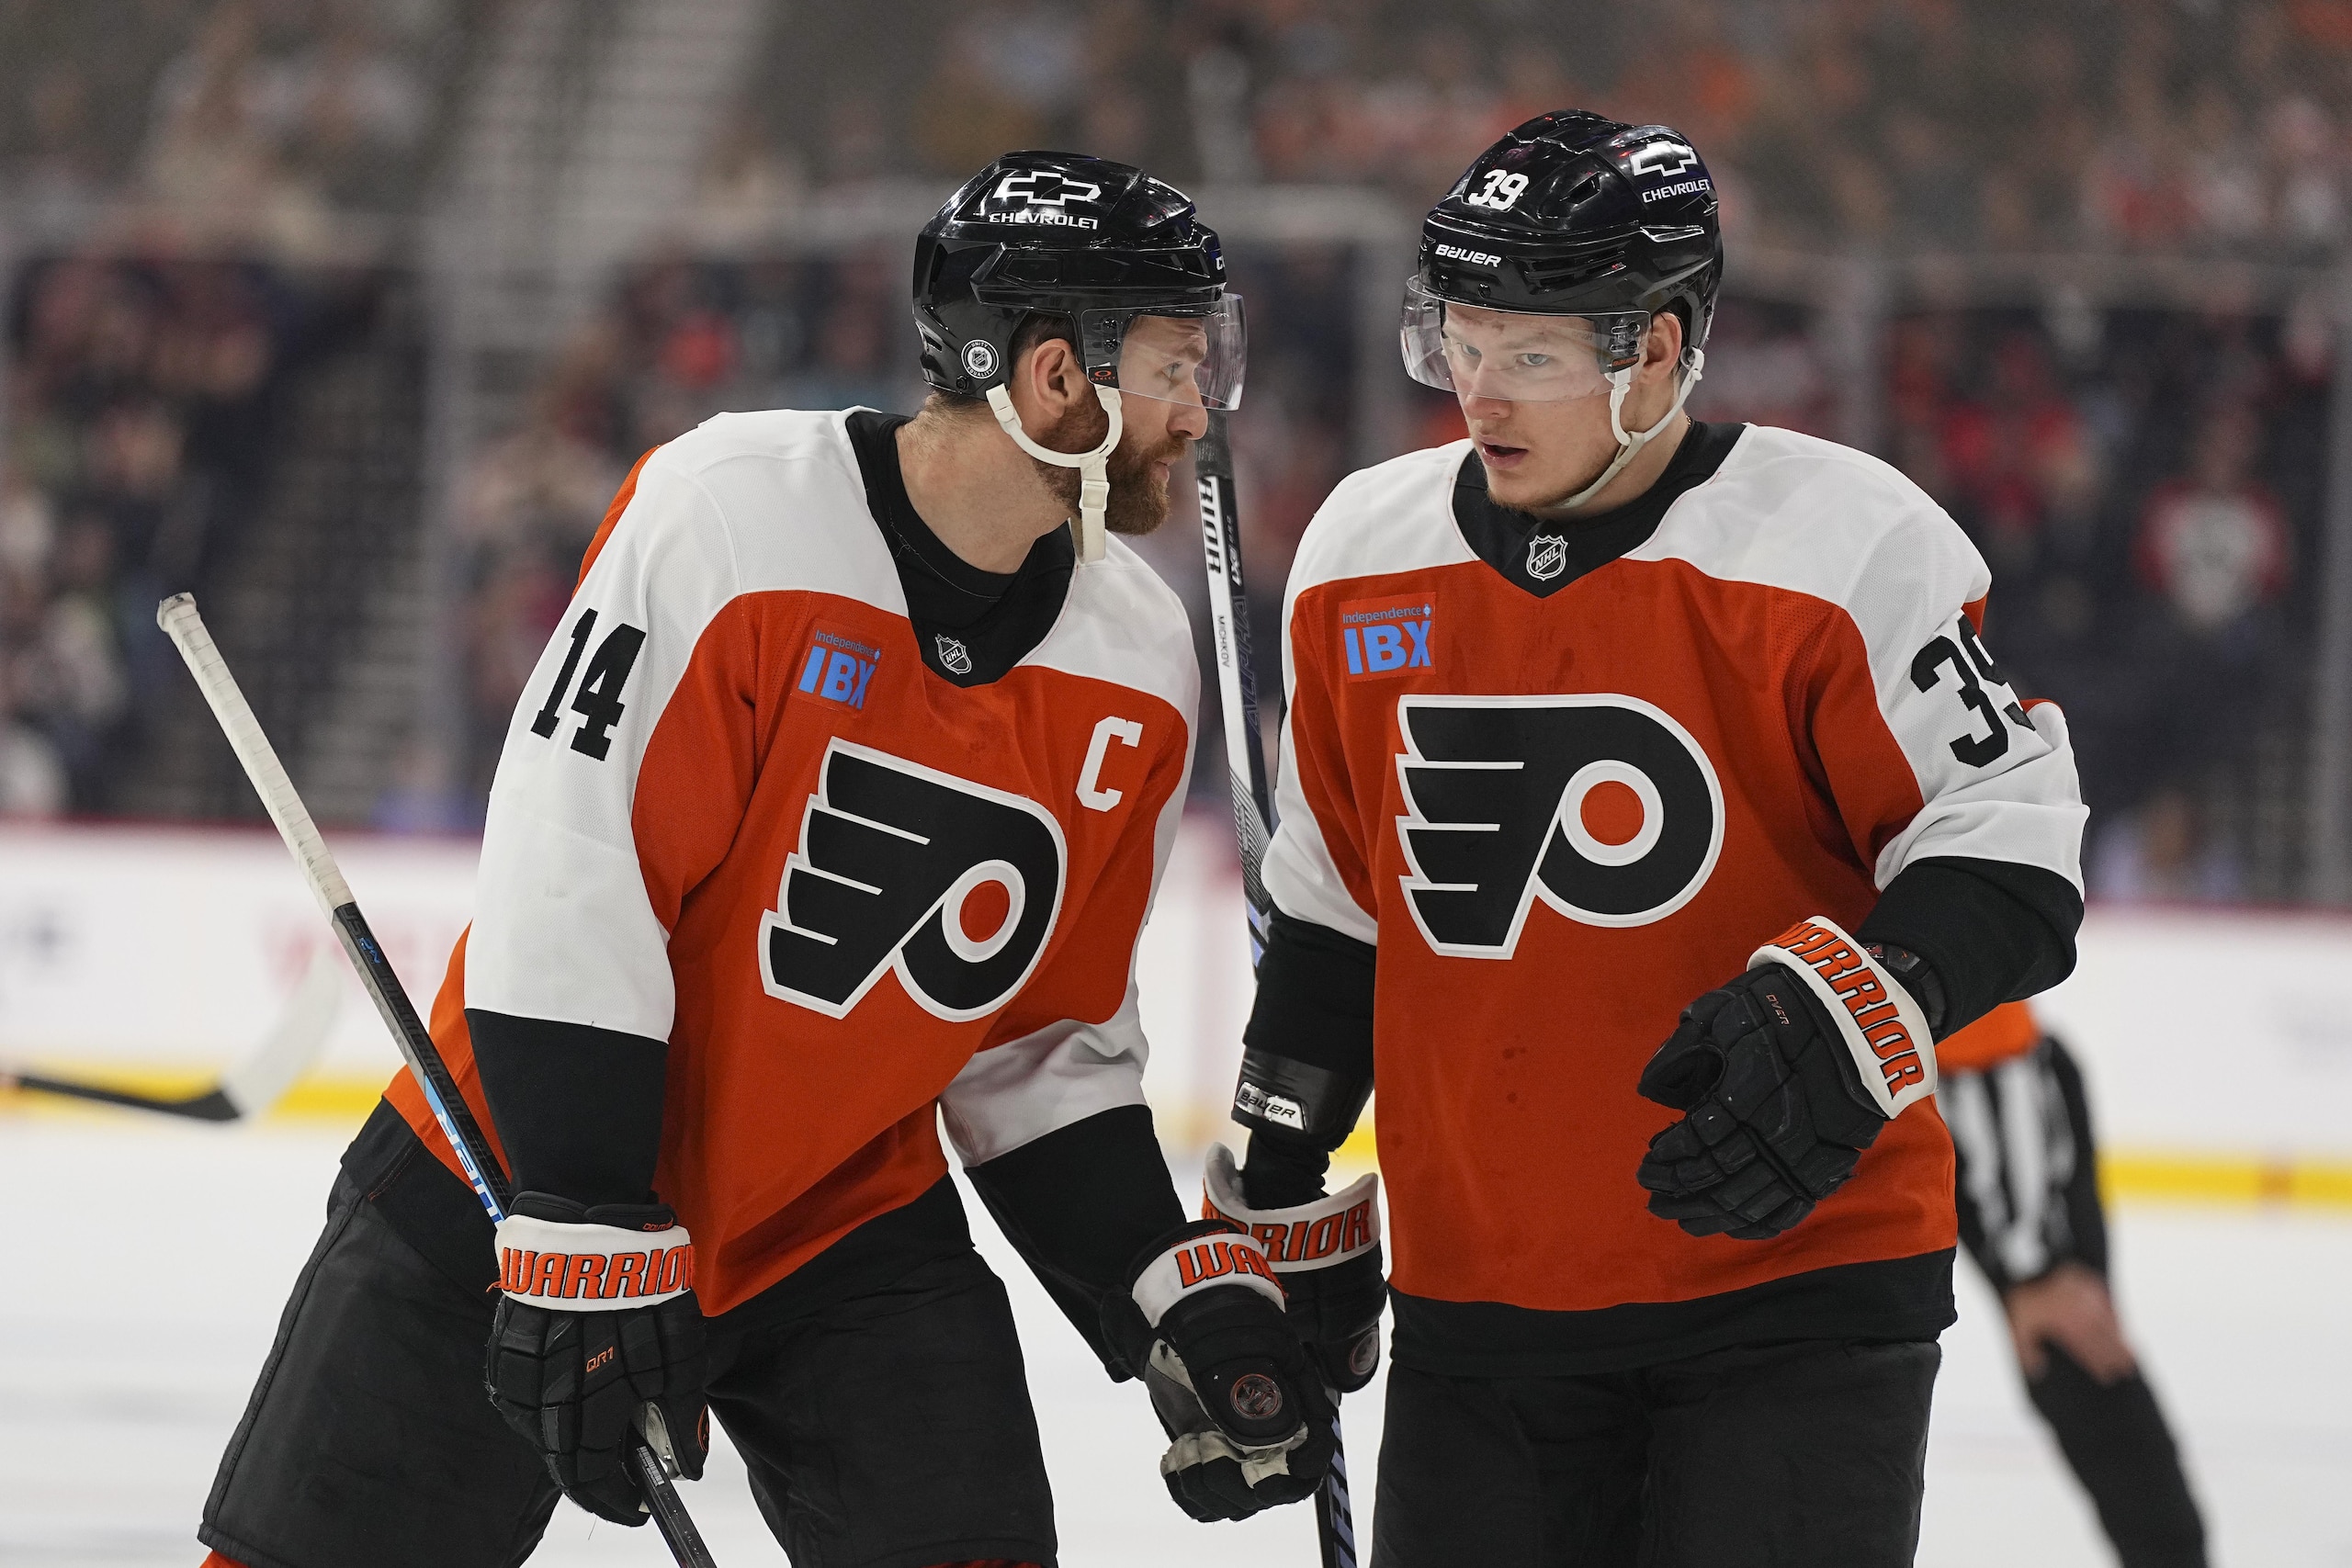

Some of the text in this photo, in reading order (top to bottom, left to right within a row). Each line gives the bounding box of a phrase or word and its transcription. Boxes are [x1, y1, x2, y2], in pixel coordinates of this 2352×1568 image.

[1468, 169, 1529, 211] 39
[1643, 179, 1710, 203] CHEVROLET
[989, 212, 1098, 230] CHEVROLET
[1435, 244, 1501, 267] BAUER
[967, 367, 992, 377] EQUALITY
[1535, 547, 1559, 570] NHL
[1342, 607, 1421, 624] Independence
[815, 629, 874, 658] Independence
[1217, 615, 1229, 668] MICHKOV
[1343, 620, 1431, 675] IBX
[945, 649, 962, 663] NHL
[532, 607, 646, 761] 14
[797, 645, 876, 710] IBX
[1075, 716, 1141, 812] C
[1240, 1092, 1295, 1118] BAUER
[435, 1108, 503, 1223] UER
[586, 1346, 614, 1372] QR1
